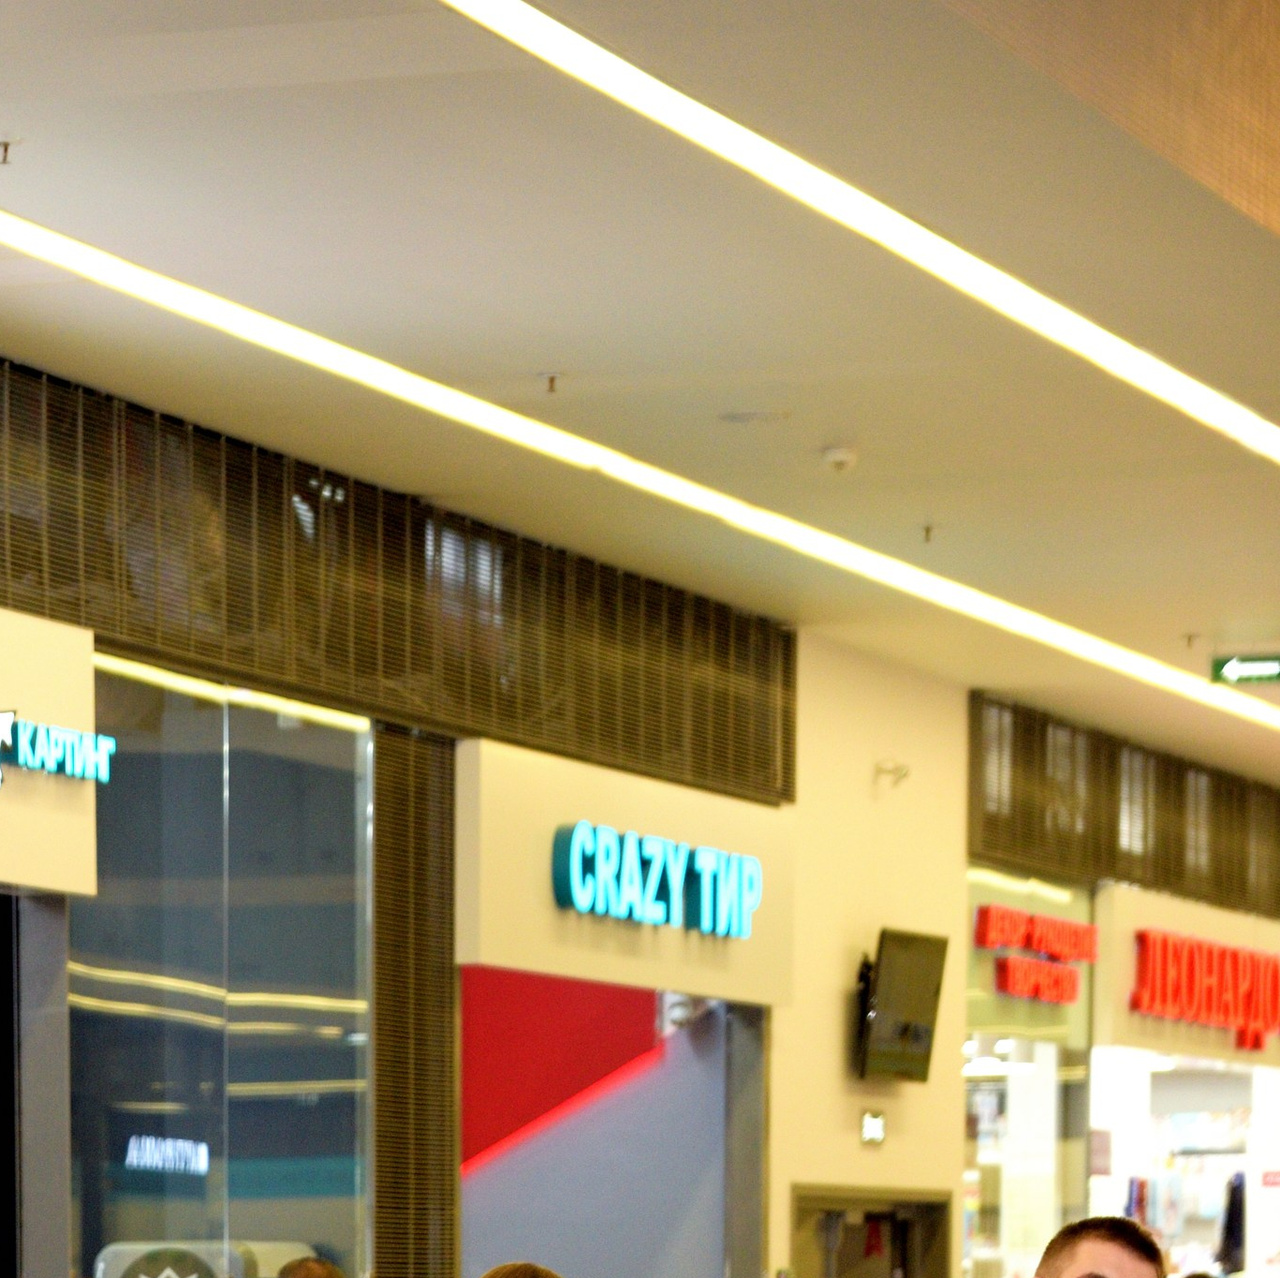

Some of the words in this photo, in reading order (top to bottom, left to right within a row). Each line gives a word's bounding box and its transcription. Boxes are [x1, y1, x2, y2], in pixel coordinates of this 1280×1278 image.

[17, 717, 118, 785] КАРТИНГ
[568, 818, 691, 929] CRAZY
[693, 845, 764, 940] ТИР
